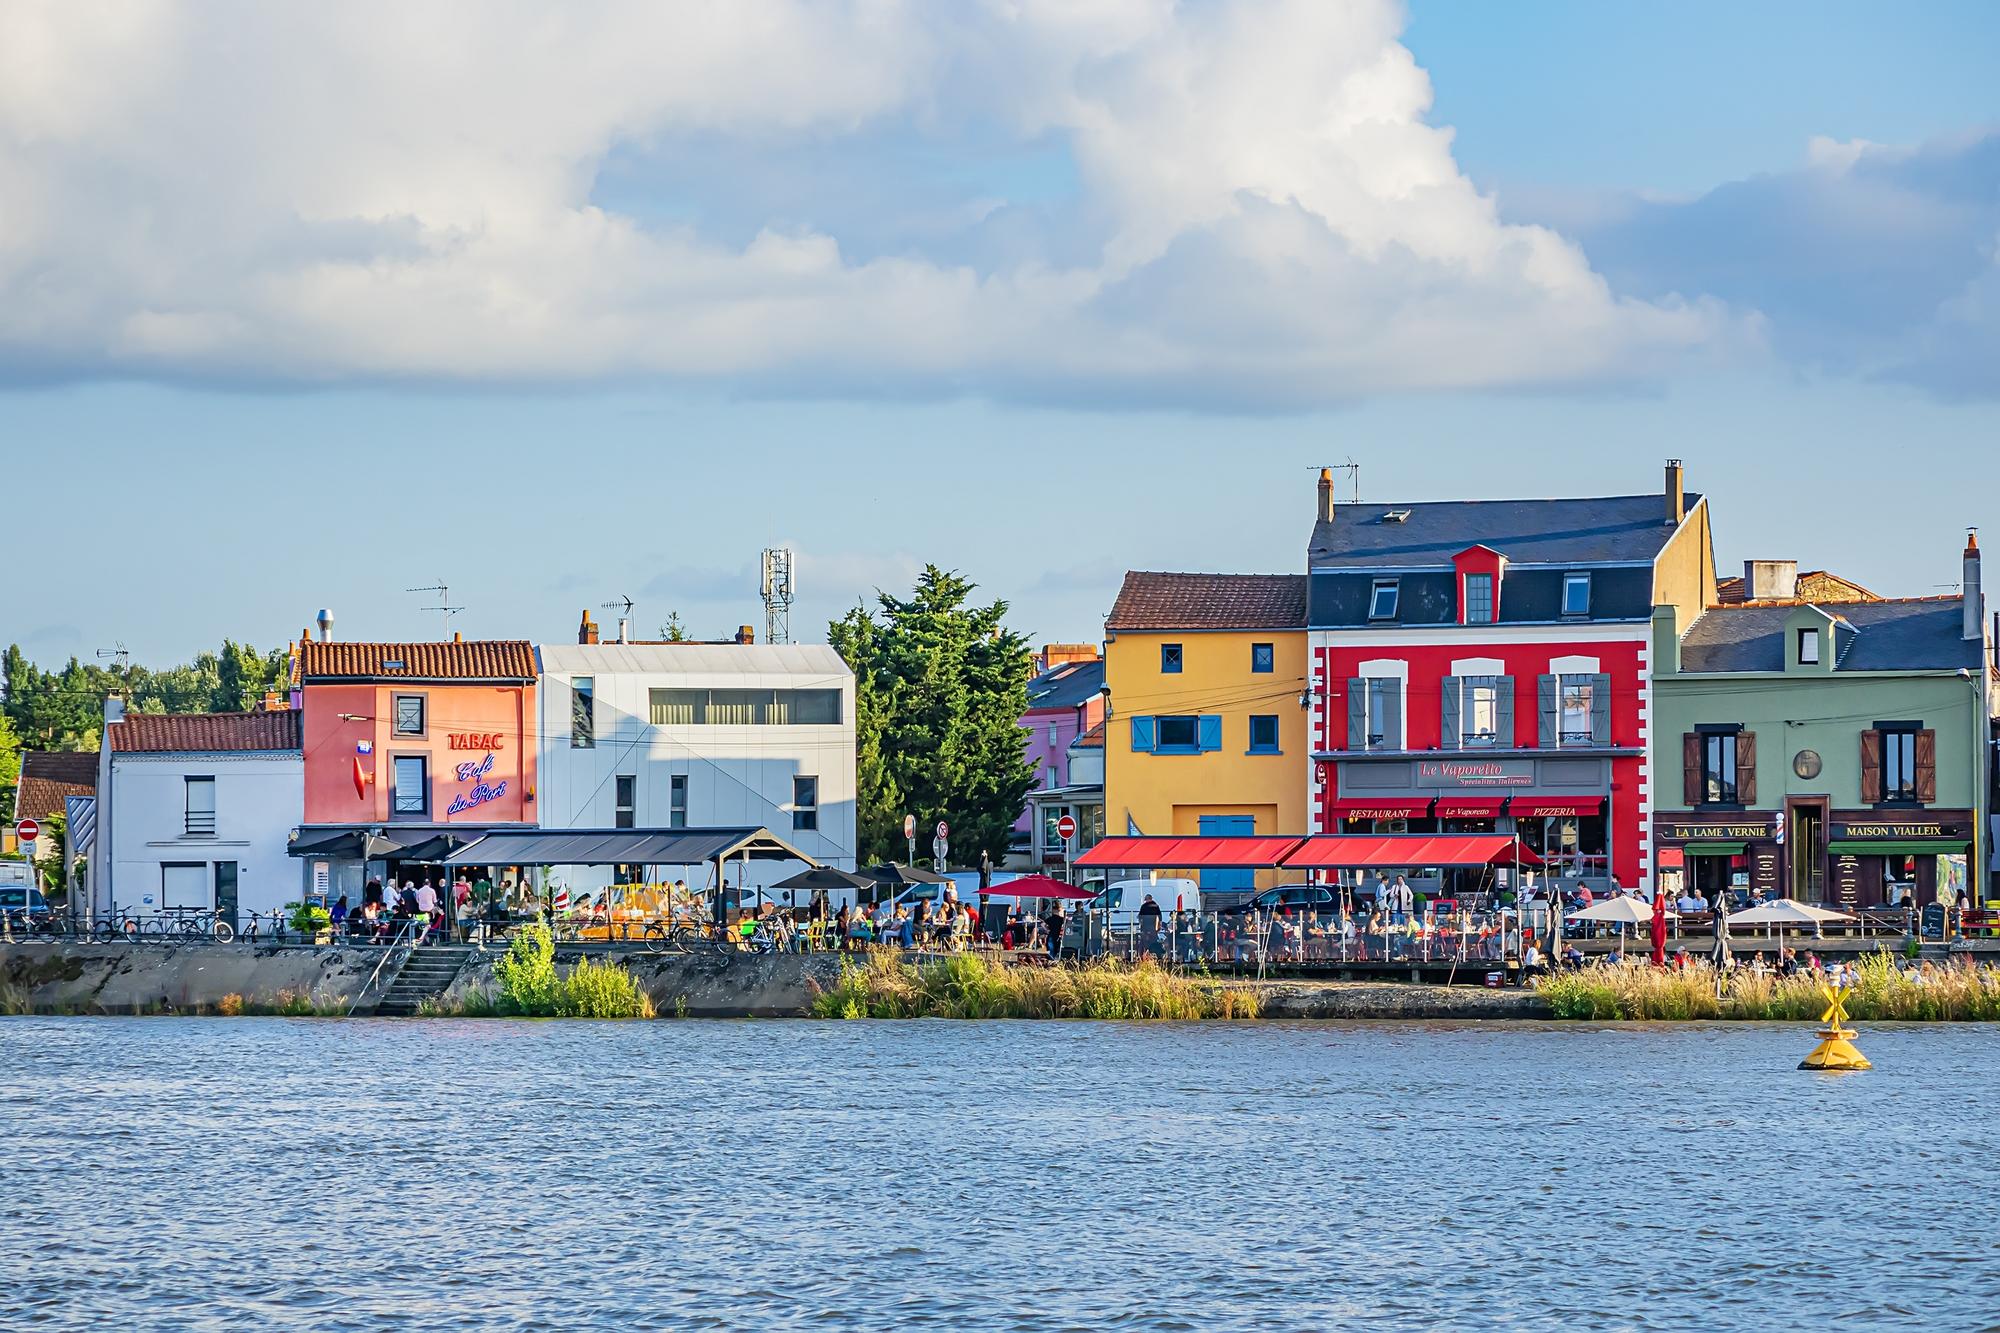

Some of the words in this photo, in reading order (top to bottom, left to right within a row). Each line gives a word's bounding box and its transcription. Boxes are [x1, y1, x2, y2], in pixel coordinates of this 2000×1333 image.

[448, 733, 503, 750] TABAC
[1421, 762, 1437, 776] Le
[1441, 762, 1502, 779] Vaporetto
[448, 794, 467, 815] du
[469, 781, 508, 808] Port
[1349, 809, 1411, 818] RESTAURANT
[1445, 808, 1456, 816] Le
[1457, 807, 1490, 816] Vaporetto
[1533, 808, 1576, 816] PIZZERIA
[1676, 828, 1690, 837] LA
[1694, 827, 1724, 837] LAME
[1728, 827, 1767, 837] VERNIE
[1847, 827, 1889, 836] MAISON
[1893, 826, 1942, 836] VIALLEIX
